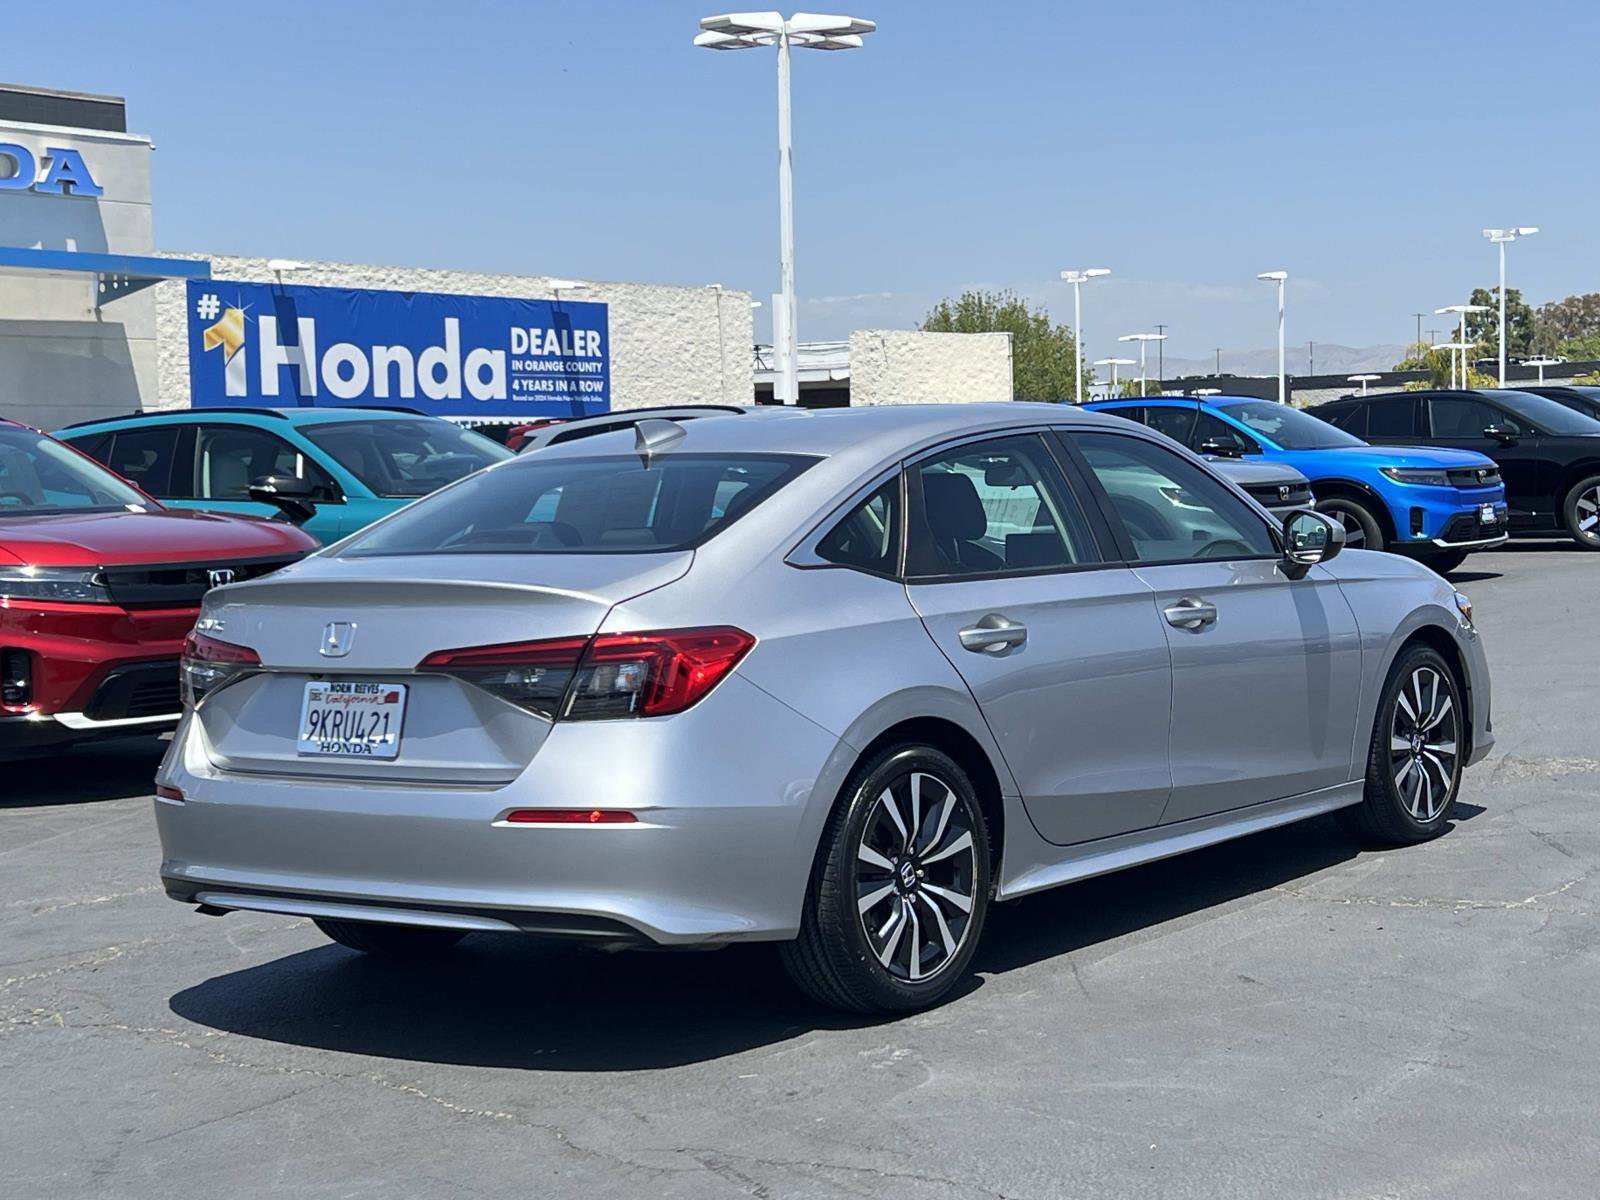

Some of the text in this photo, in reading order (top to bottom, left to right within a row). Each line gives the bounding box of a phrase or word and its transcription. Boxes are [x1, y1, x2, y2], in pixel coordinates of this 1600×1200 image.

[511, 327, 602, 357] DEALER
[258, 315, 507, 401] Honda
[512, 360, 602, 372] IN ORANGE COUNTY
[512, 379, 604, 392] 4 YEARS IN A ROW
[325, 694, 384, 709] California
[307, 709, 389, 743] 9KRU421
[320, 742, 372, 754] HONDA
